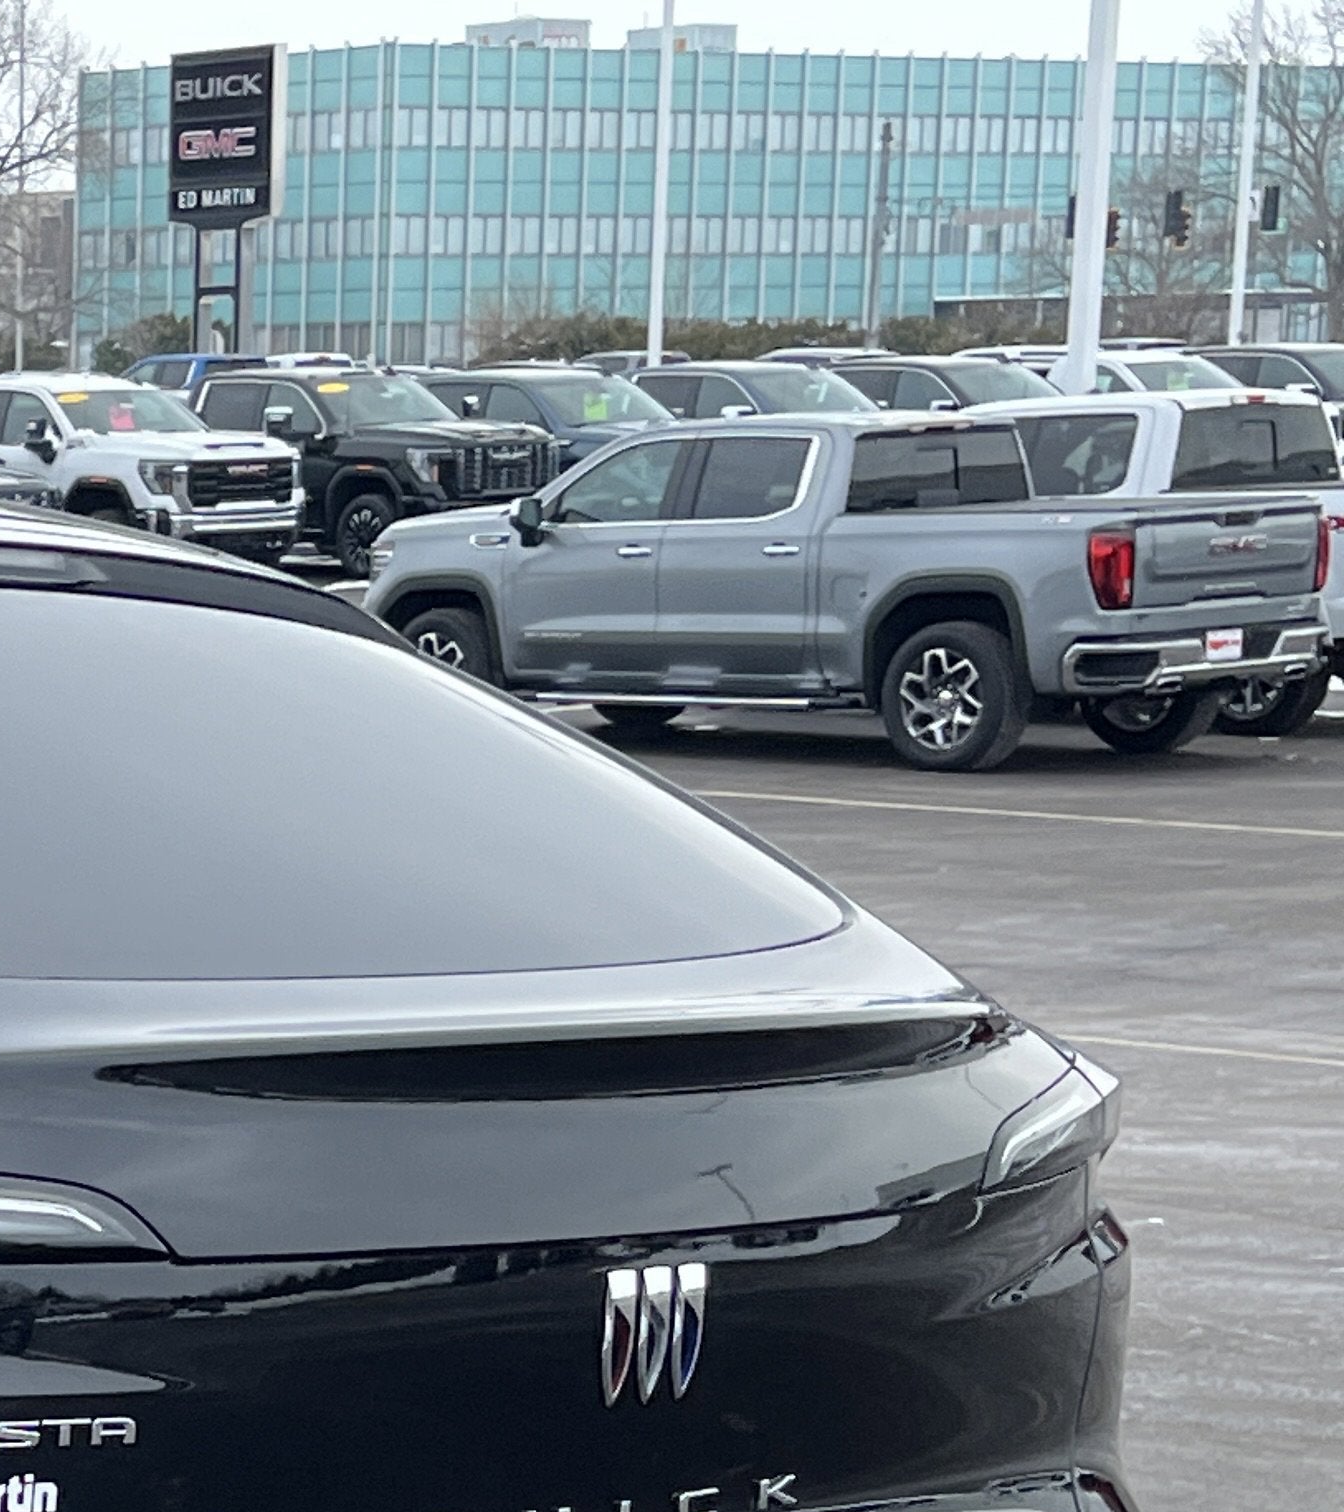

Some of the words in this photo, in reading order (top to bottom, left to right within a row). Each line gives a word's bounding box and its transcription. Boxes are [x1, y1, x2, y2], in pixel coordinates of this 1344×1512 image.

[174, 73, 263, 102] BUICK
[178, 126, 257, 161] GMC
[177, 191, 198, 209] ED
[201, 188, 256, 207] MARTIN
